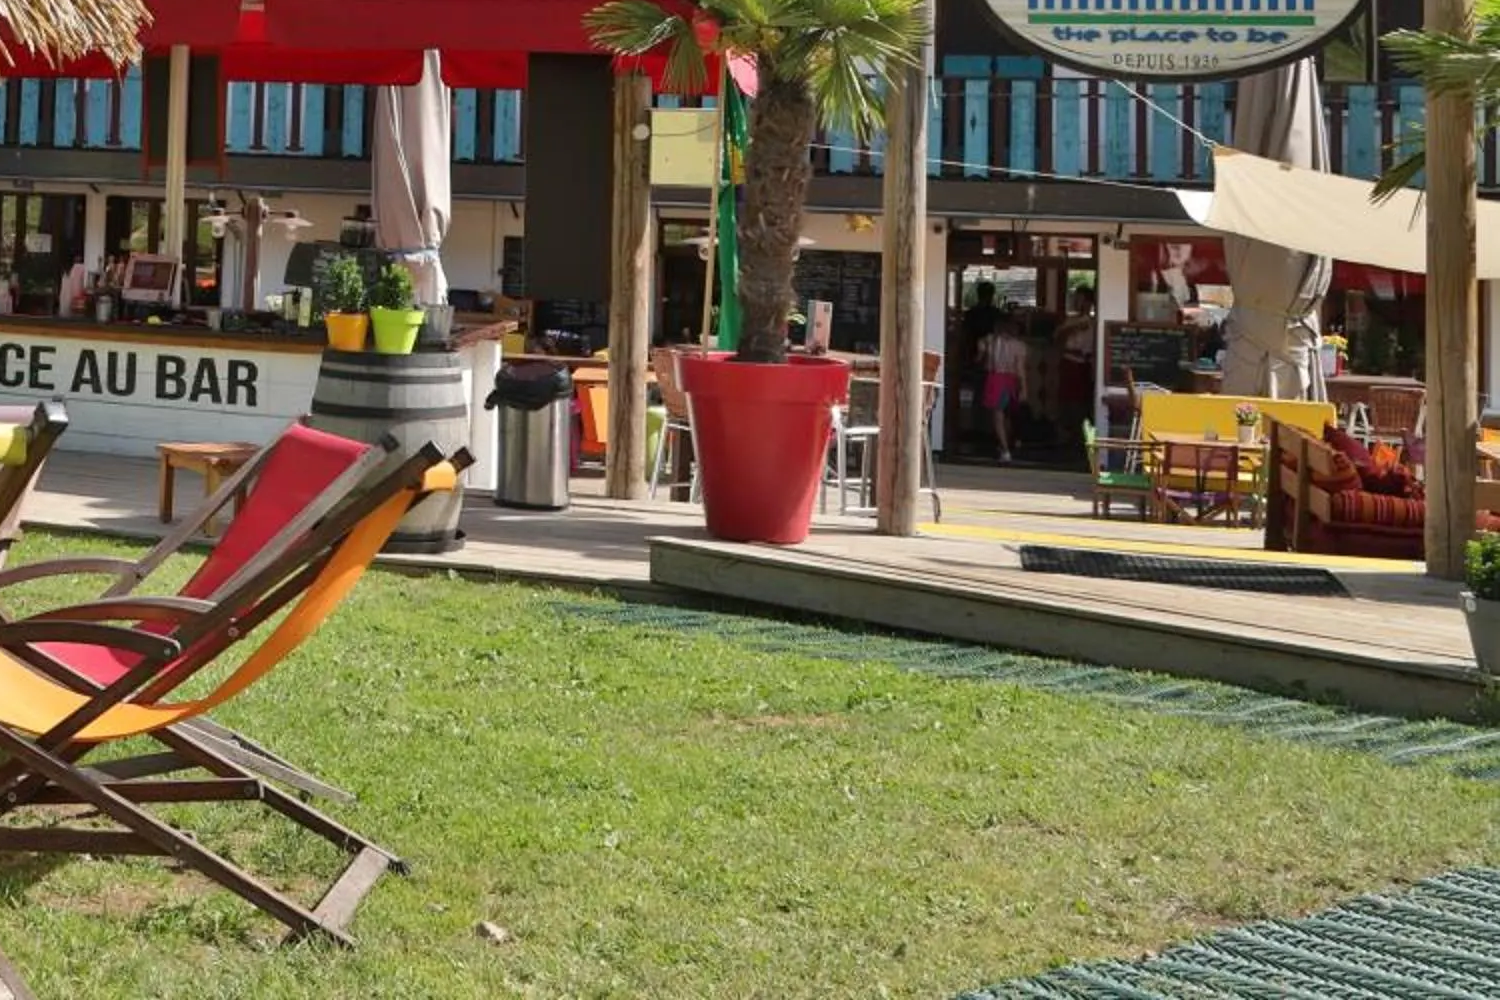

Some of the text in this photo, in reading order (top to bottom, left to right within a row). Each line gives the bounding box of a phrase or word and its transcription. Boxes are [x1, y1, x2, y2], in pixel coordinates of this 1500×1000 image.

[1112, 53, 1175, 70] DEPUIS
[71, 349, 137, 397] AU
[155, 354, 259, 407] BAR
